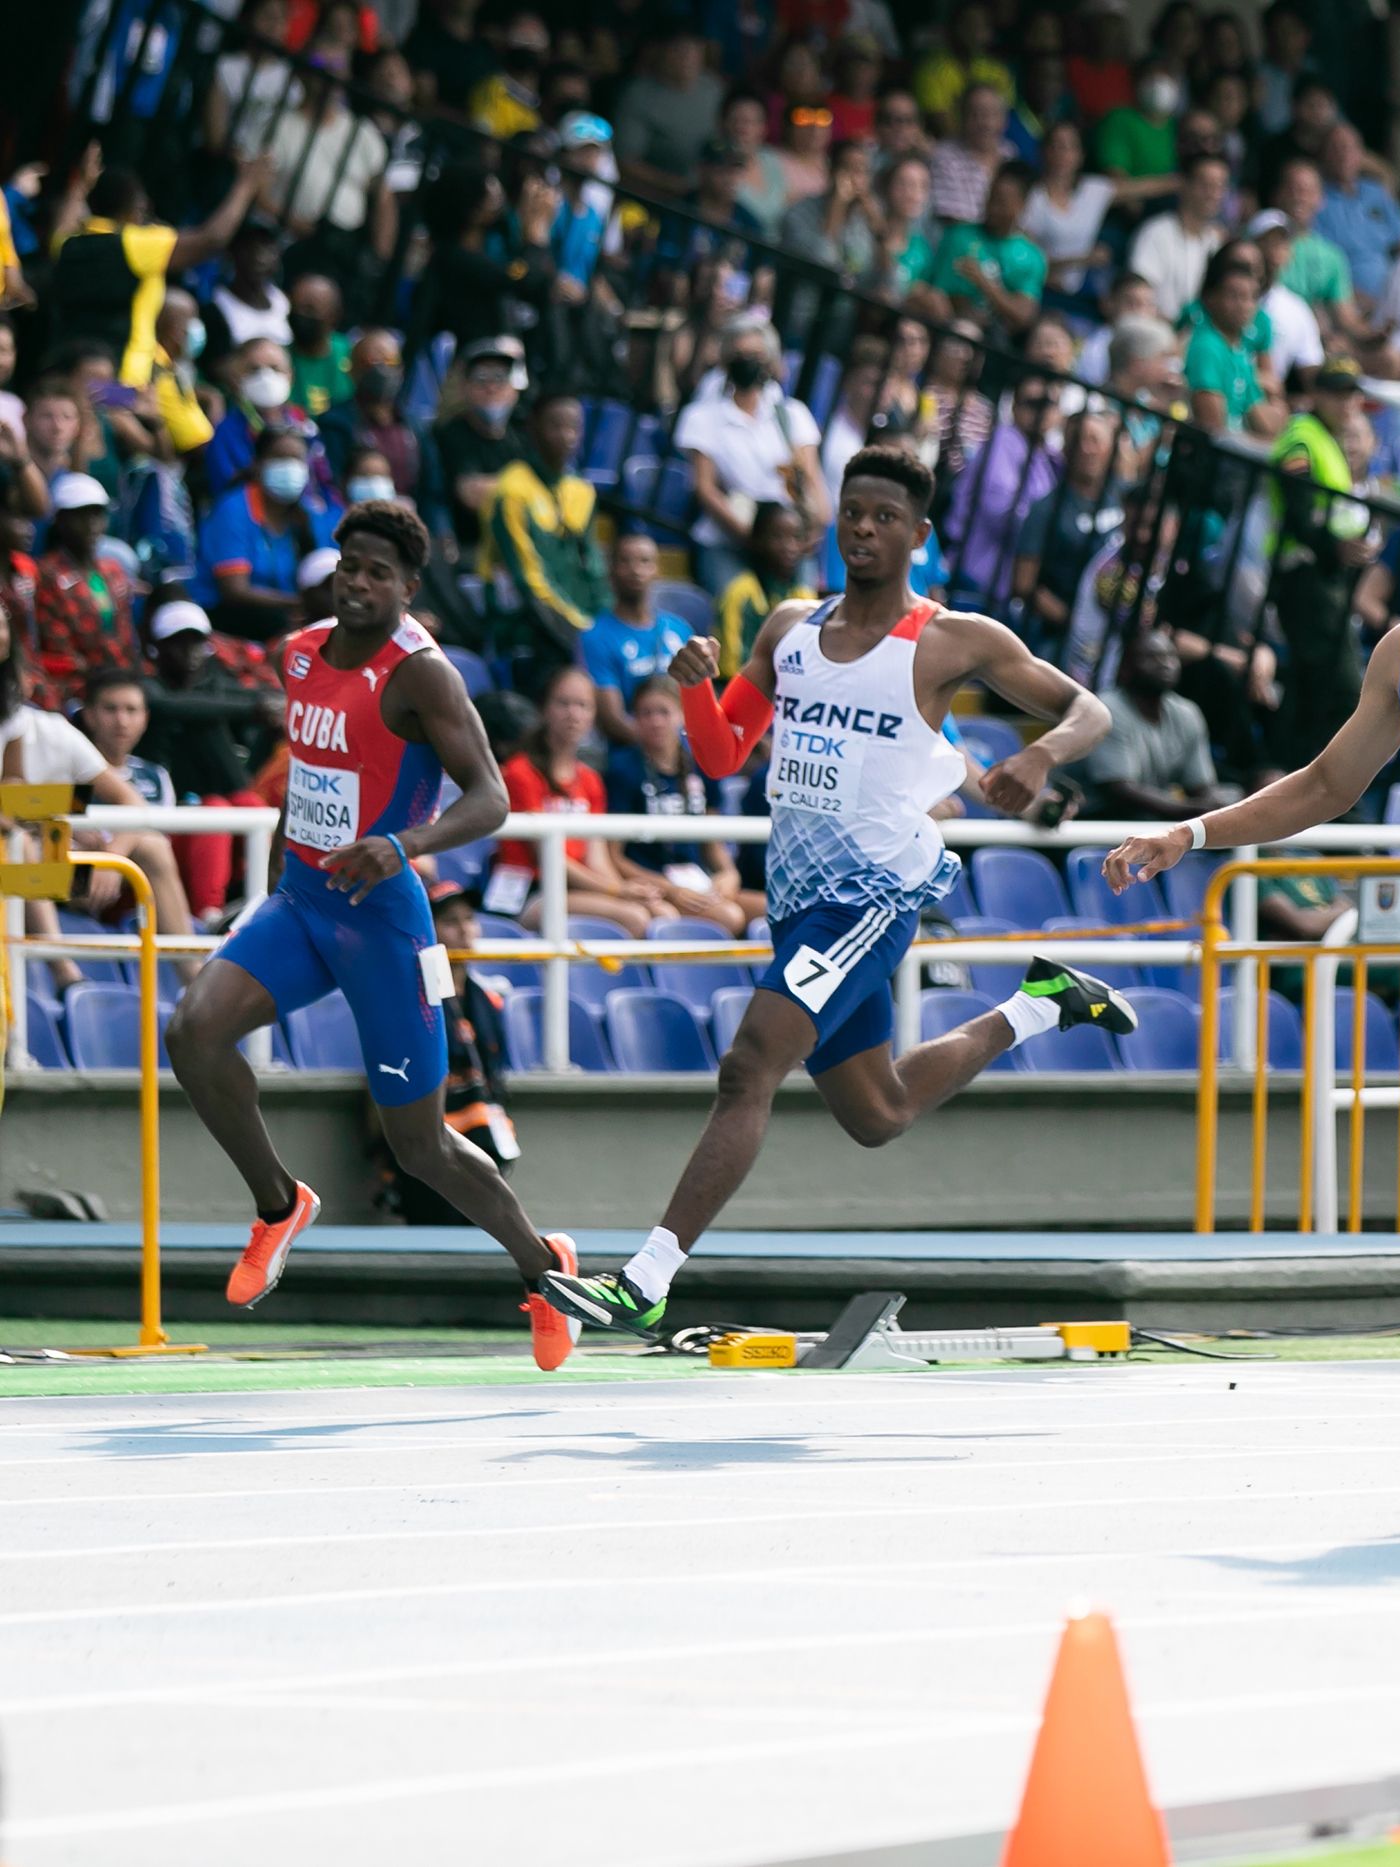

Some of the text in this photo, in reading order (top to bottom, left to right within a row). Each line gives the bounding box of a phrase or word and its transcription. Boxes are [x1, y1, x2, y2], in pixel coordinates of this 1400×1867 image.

[288, 700, 349, 754] CUBA
[791, 731, 847, 759] TDK
[301, 768, 343, 796] TDK
[778, 757, 839, 790] ERIUS
[289, 791, 352, 830] SPINOSA
[789, 791, 842, 813] CALI 22
[795, 958, 830, 988] 7
